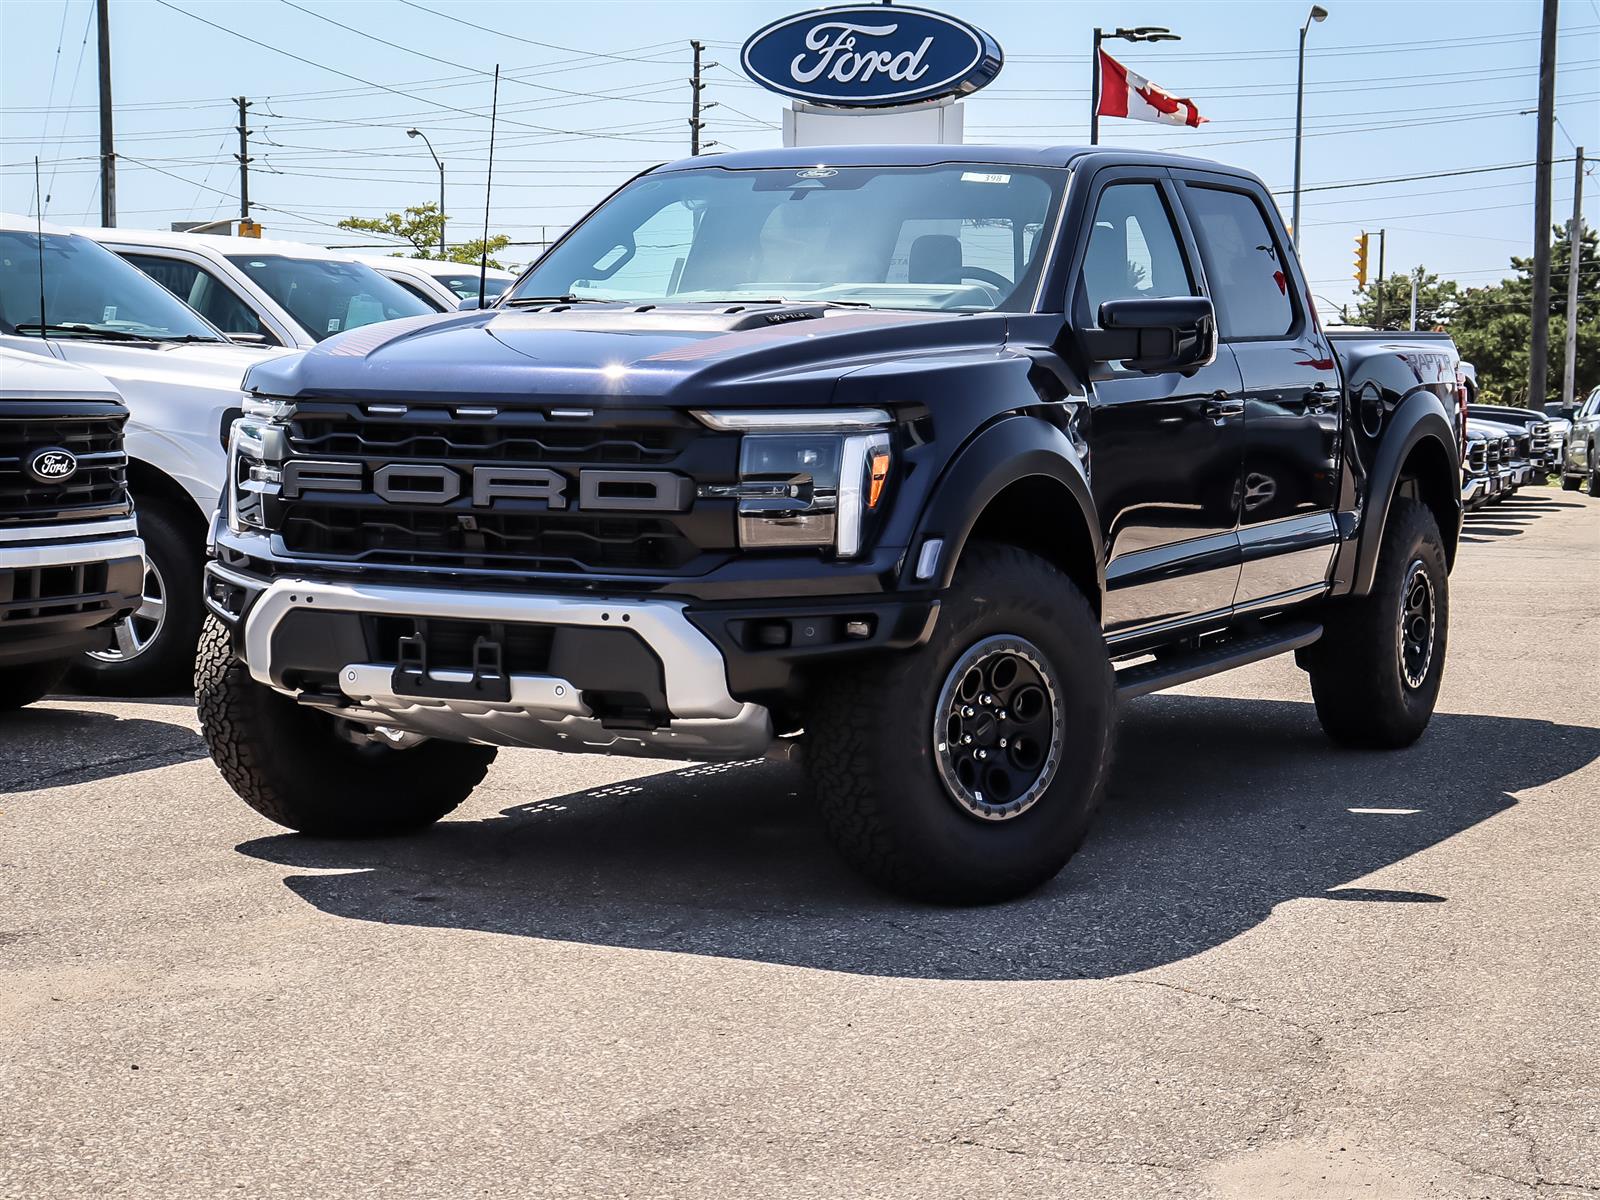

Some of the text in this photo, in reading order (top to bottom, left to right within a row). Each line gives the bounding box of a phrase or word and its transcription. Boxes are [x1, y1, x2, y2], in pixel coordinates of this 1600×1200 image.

[790, 21, 935, 83] Ford
[41, 454, 69, 474] Ford
[282, 459, 697, 512] FORD
